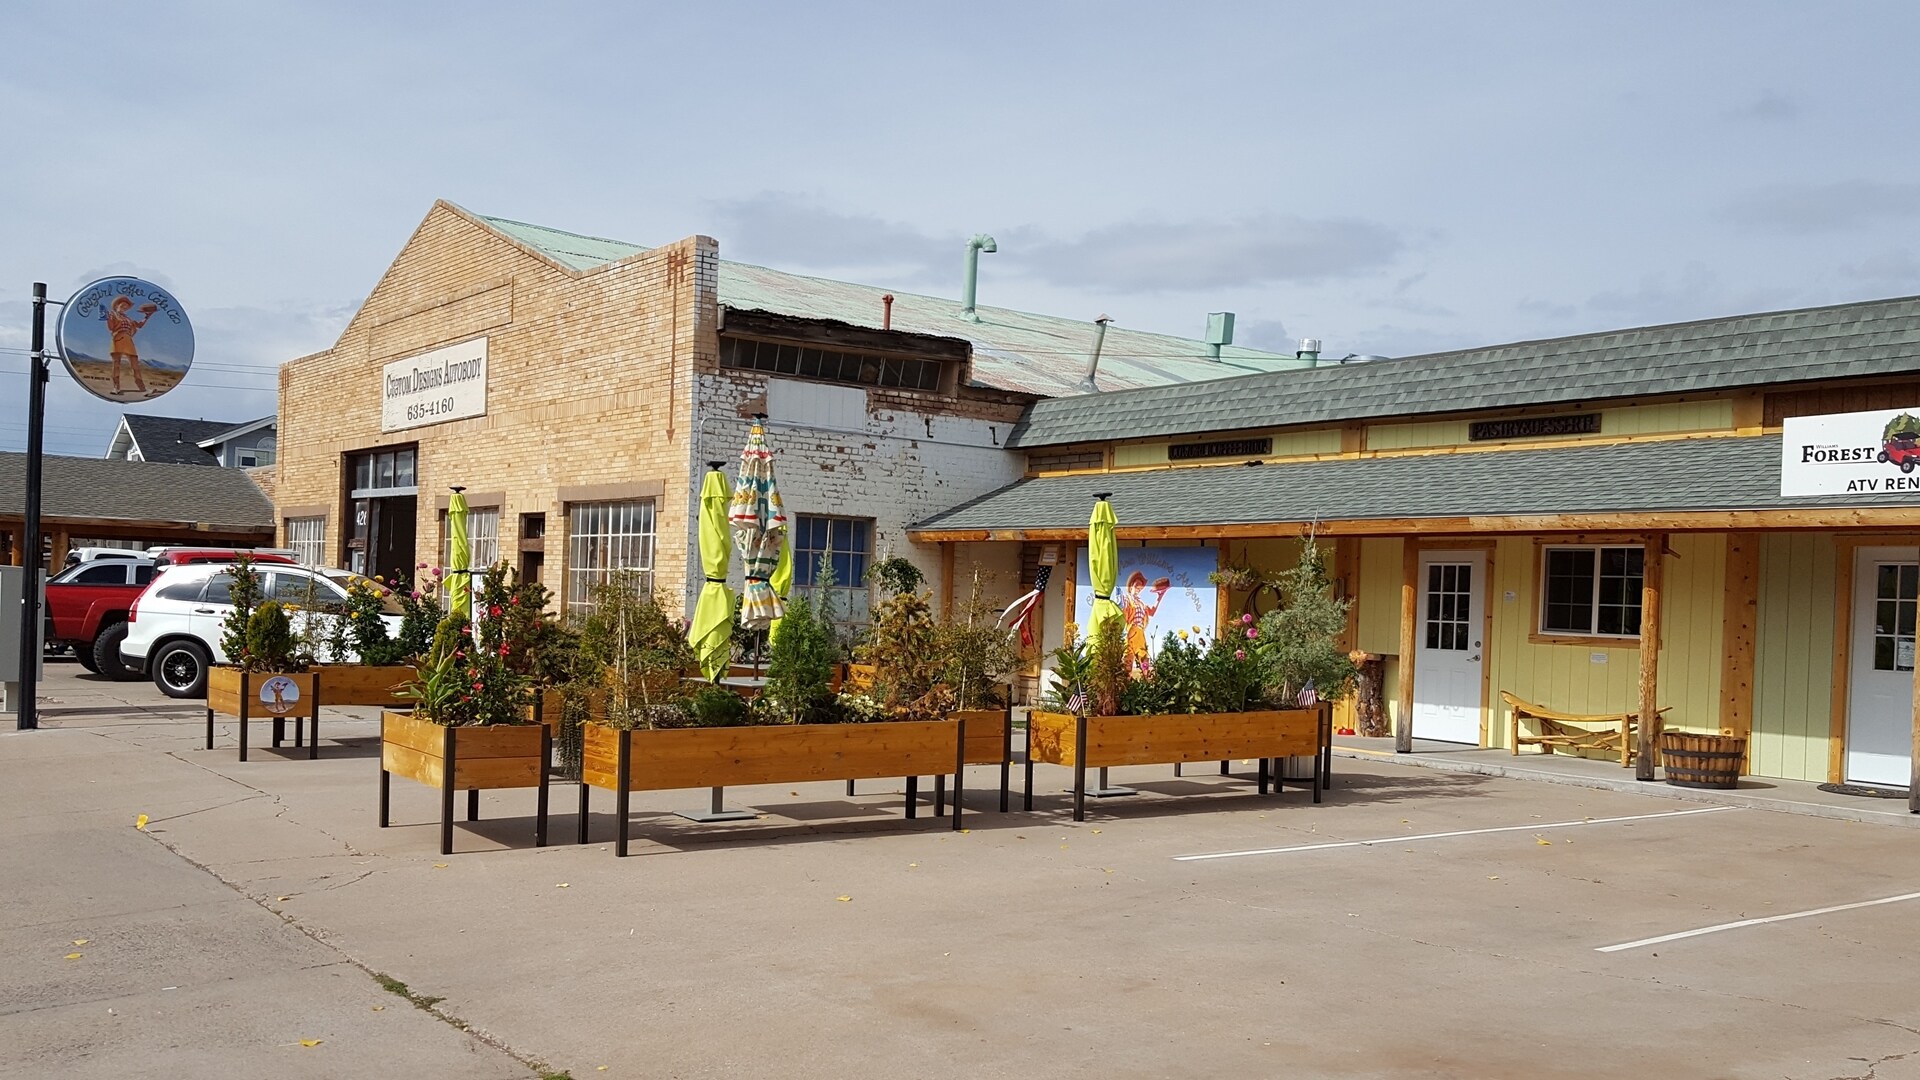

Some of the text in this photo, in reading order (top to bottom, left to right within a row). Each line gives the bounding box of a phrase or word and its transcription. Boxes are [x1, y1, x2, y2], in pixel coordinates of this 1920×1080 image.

[115, 281, 146, 297] Coffee
[407, 396, 454, 421] 635-4160
[1801, 445, 1875, 463] FOREST
[1846, 478, 1879, 492] ATV
